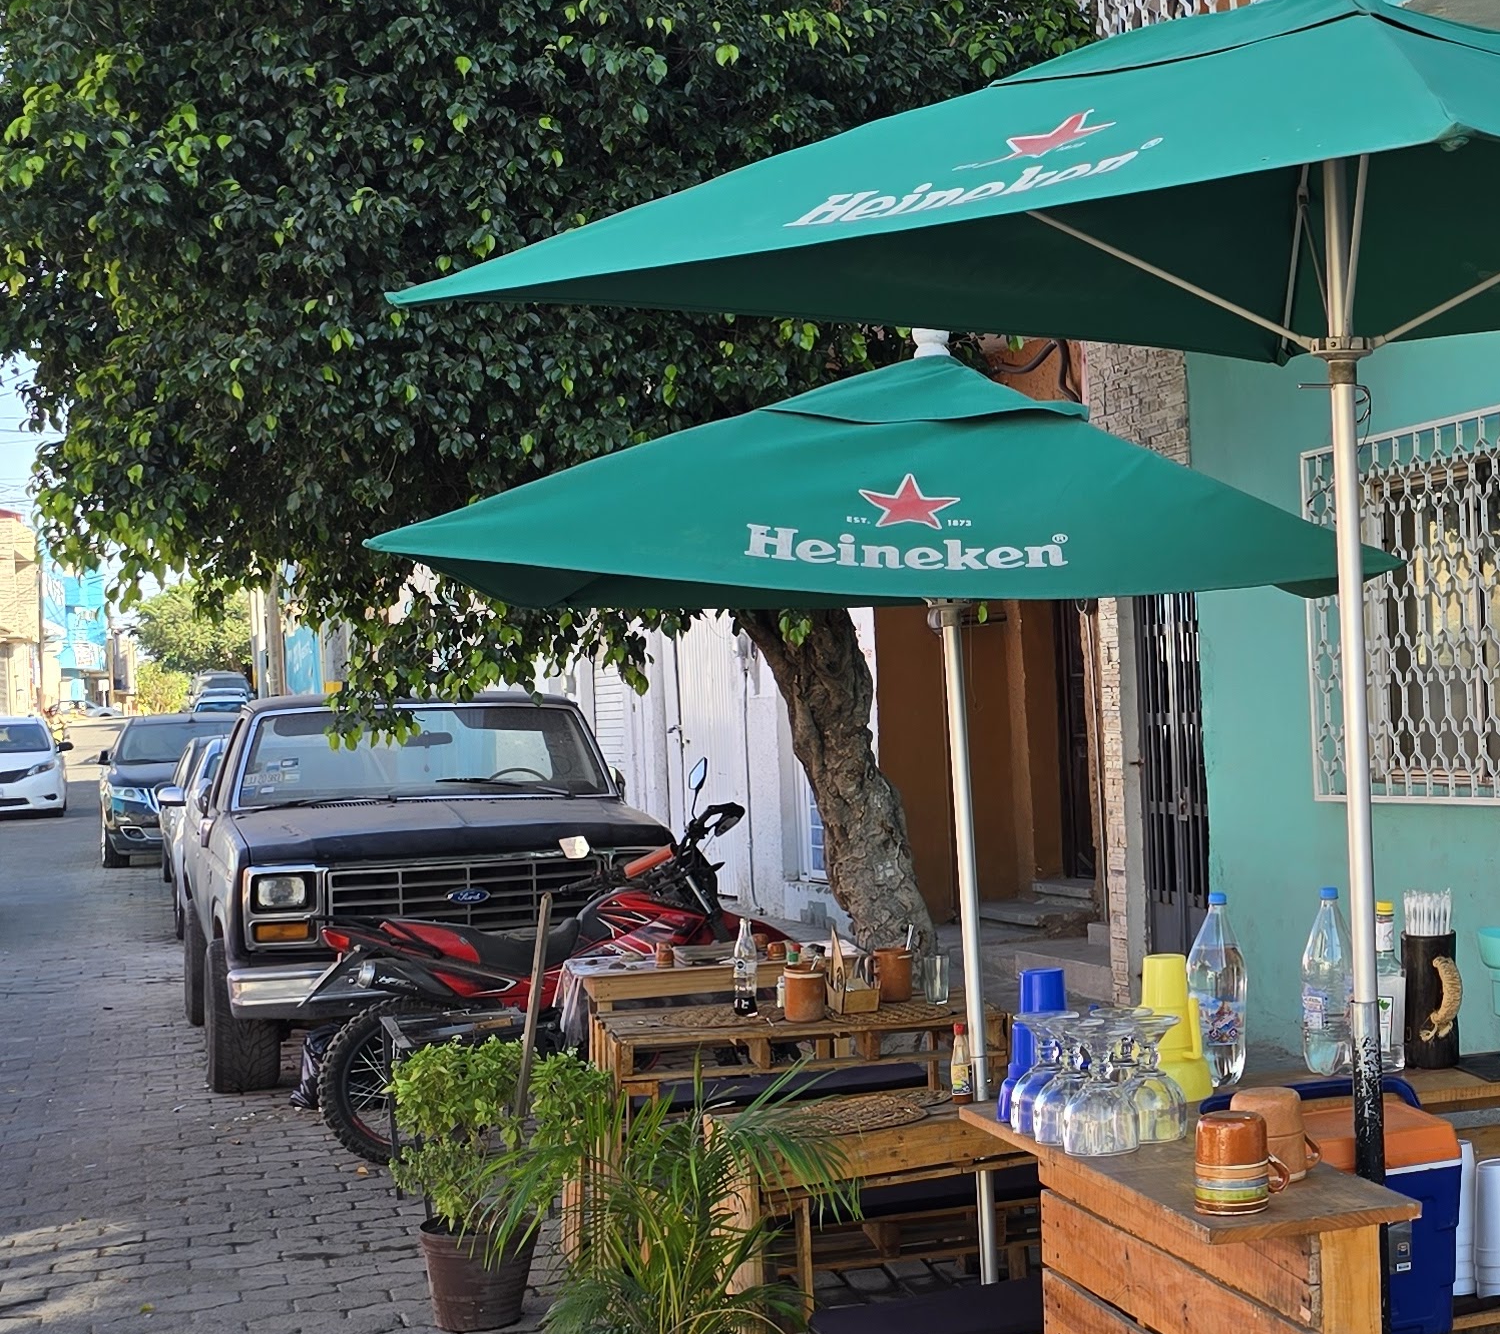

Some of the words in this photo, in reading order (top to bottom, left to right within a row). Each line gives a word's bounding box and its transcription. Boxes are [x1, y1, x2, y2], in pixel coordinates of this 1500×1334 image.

[782, 151, 1140, 227] Heineken
[744, 523, 1069, 570] Heineken
[947, 519, 972, 527] 1873
